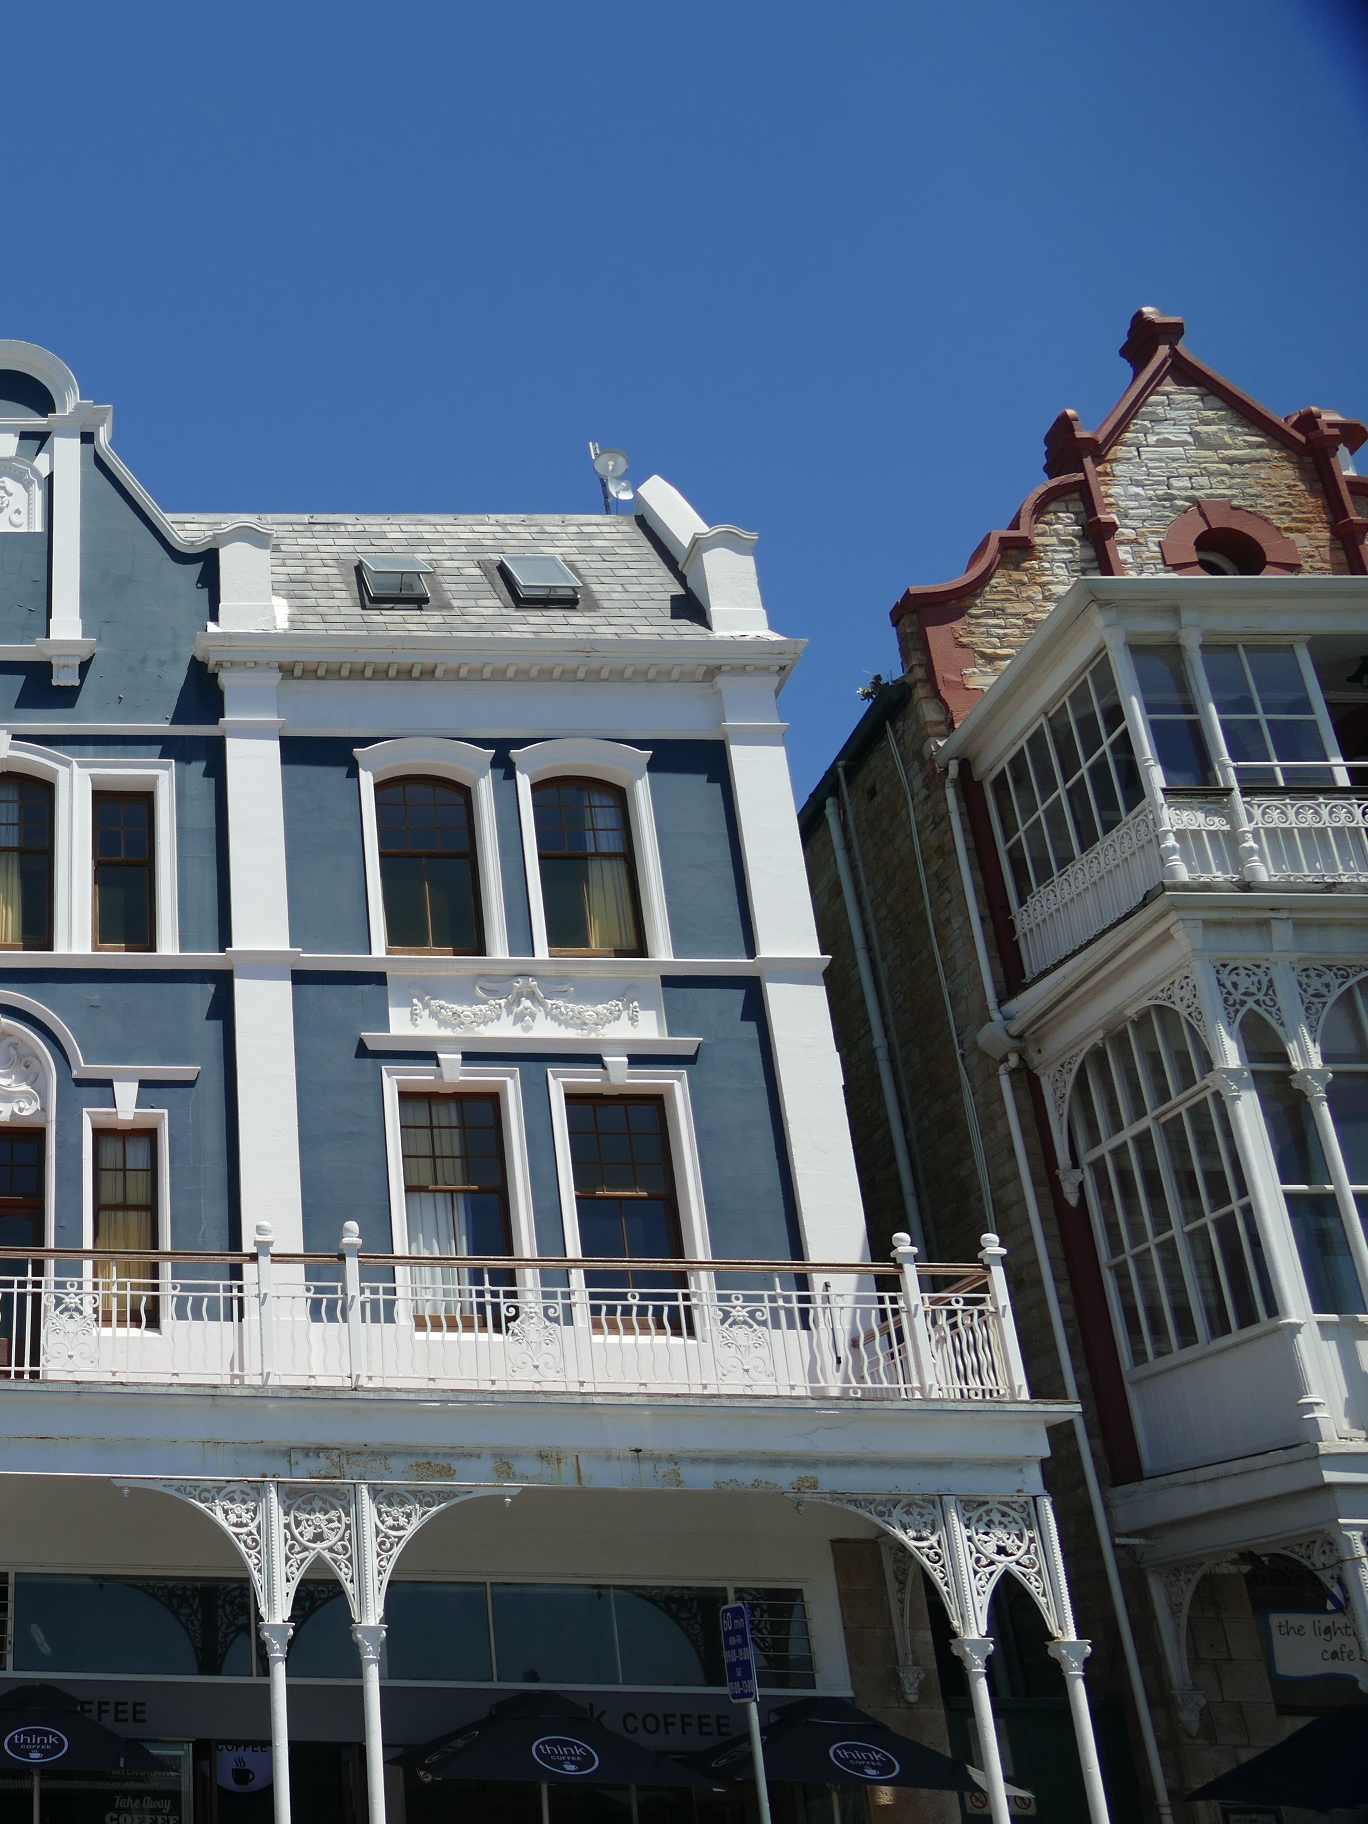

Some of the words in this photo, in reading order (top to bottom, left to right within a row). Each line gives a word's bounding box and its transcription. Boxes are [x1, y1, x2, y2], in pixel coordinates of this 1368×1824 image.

[9, 507, 25, 528] C
[723, 1611, 732, 1632] 60
[1277, 1619, 1306, 1636] the
[1313, 1619, 1356, 1642] light
[1321, 1643, 1356, 1662] cafe
[622, 1712, 732, 1737] COFFEE
[13, 1734, 59, 1744] think
[538, 1744, 588, 1756] think
[836, 1749, 887, 1761] think
[849, 1759, 883, 1767] COFFEE
[113, 1795, 141, 1808] Take
[142, 1796, 173, 1813] Away
